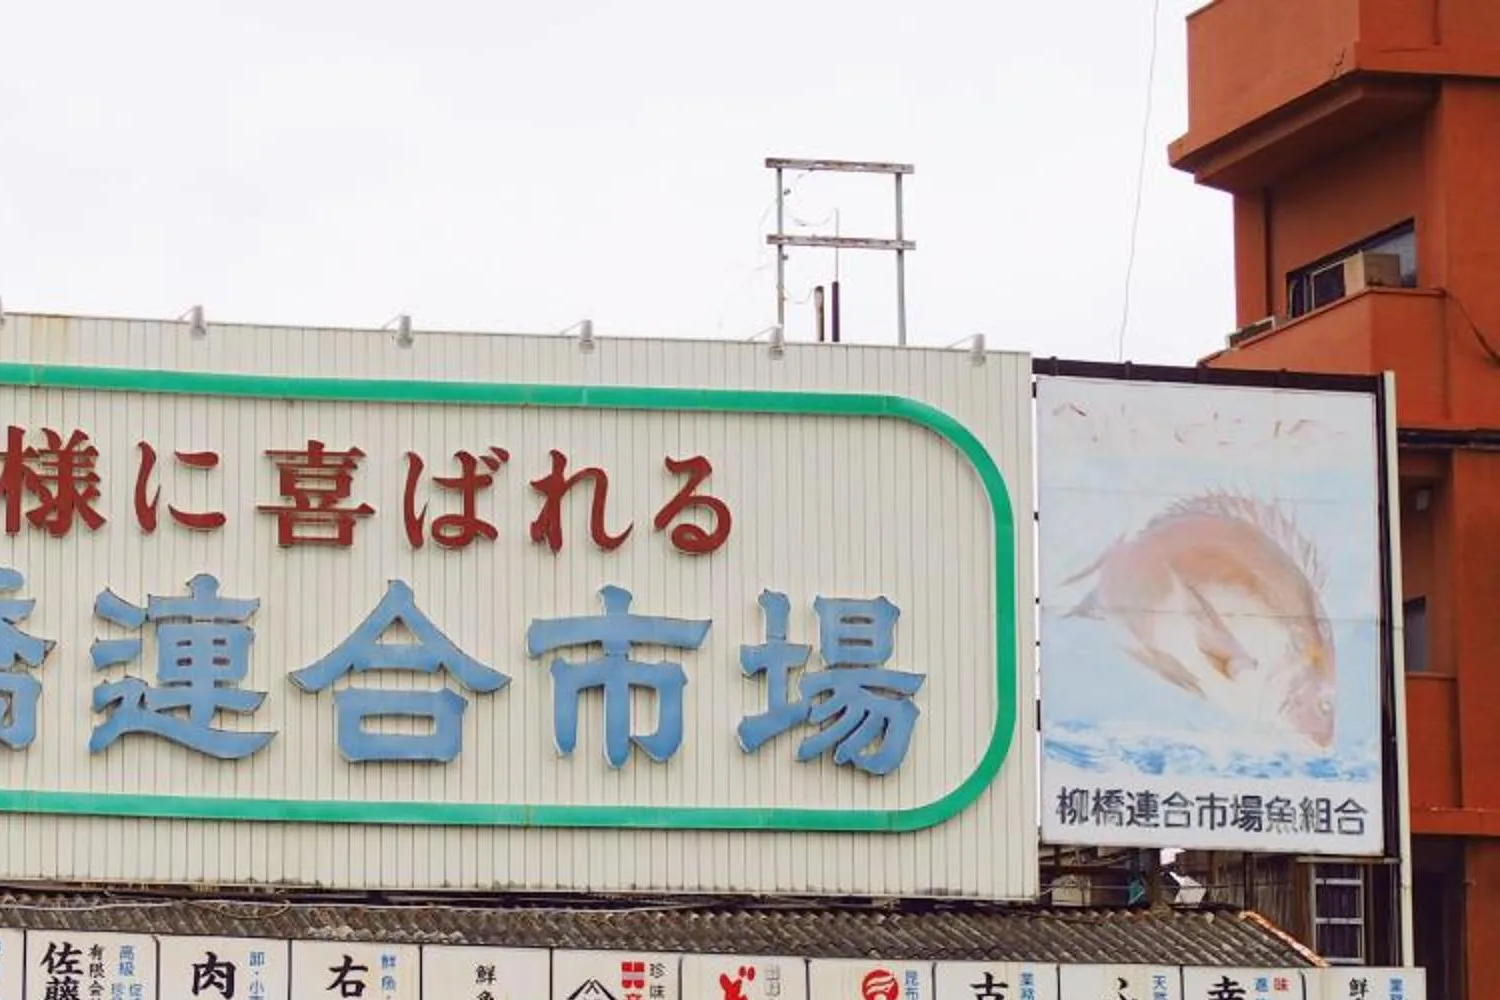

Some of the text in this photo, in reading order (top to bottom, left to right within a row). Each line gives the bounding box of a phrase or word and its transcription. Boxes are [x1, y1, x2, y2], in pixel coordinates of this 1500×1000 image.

[1056, 786, 1368, 837] 柳橋連合市場魚組合
